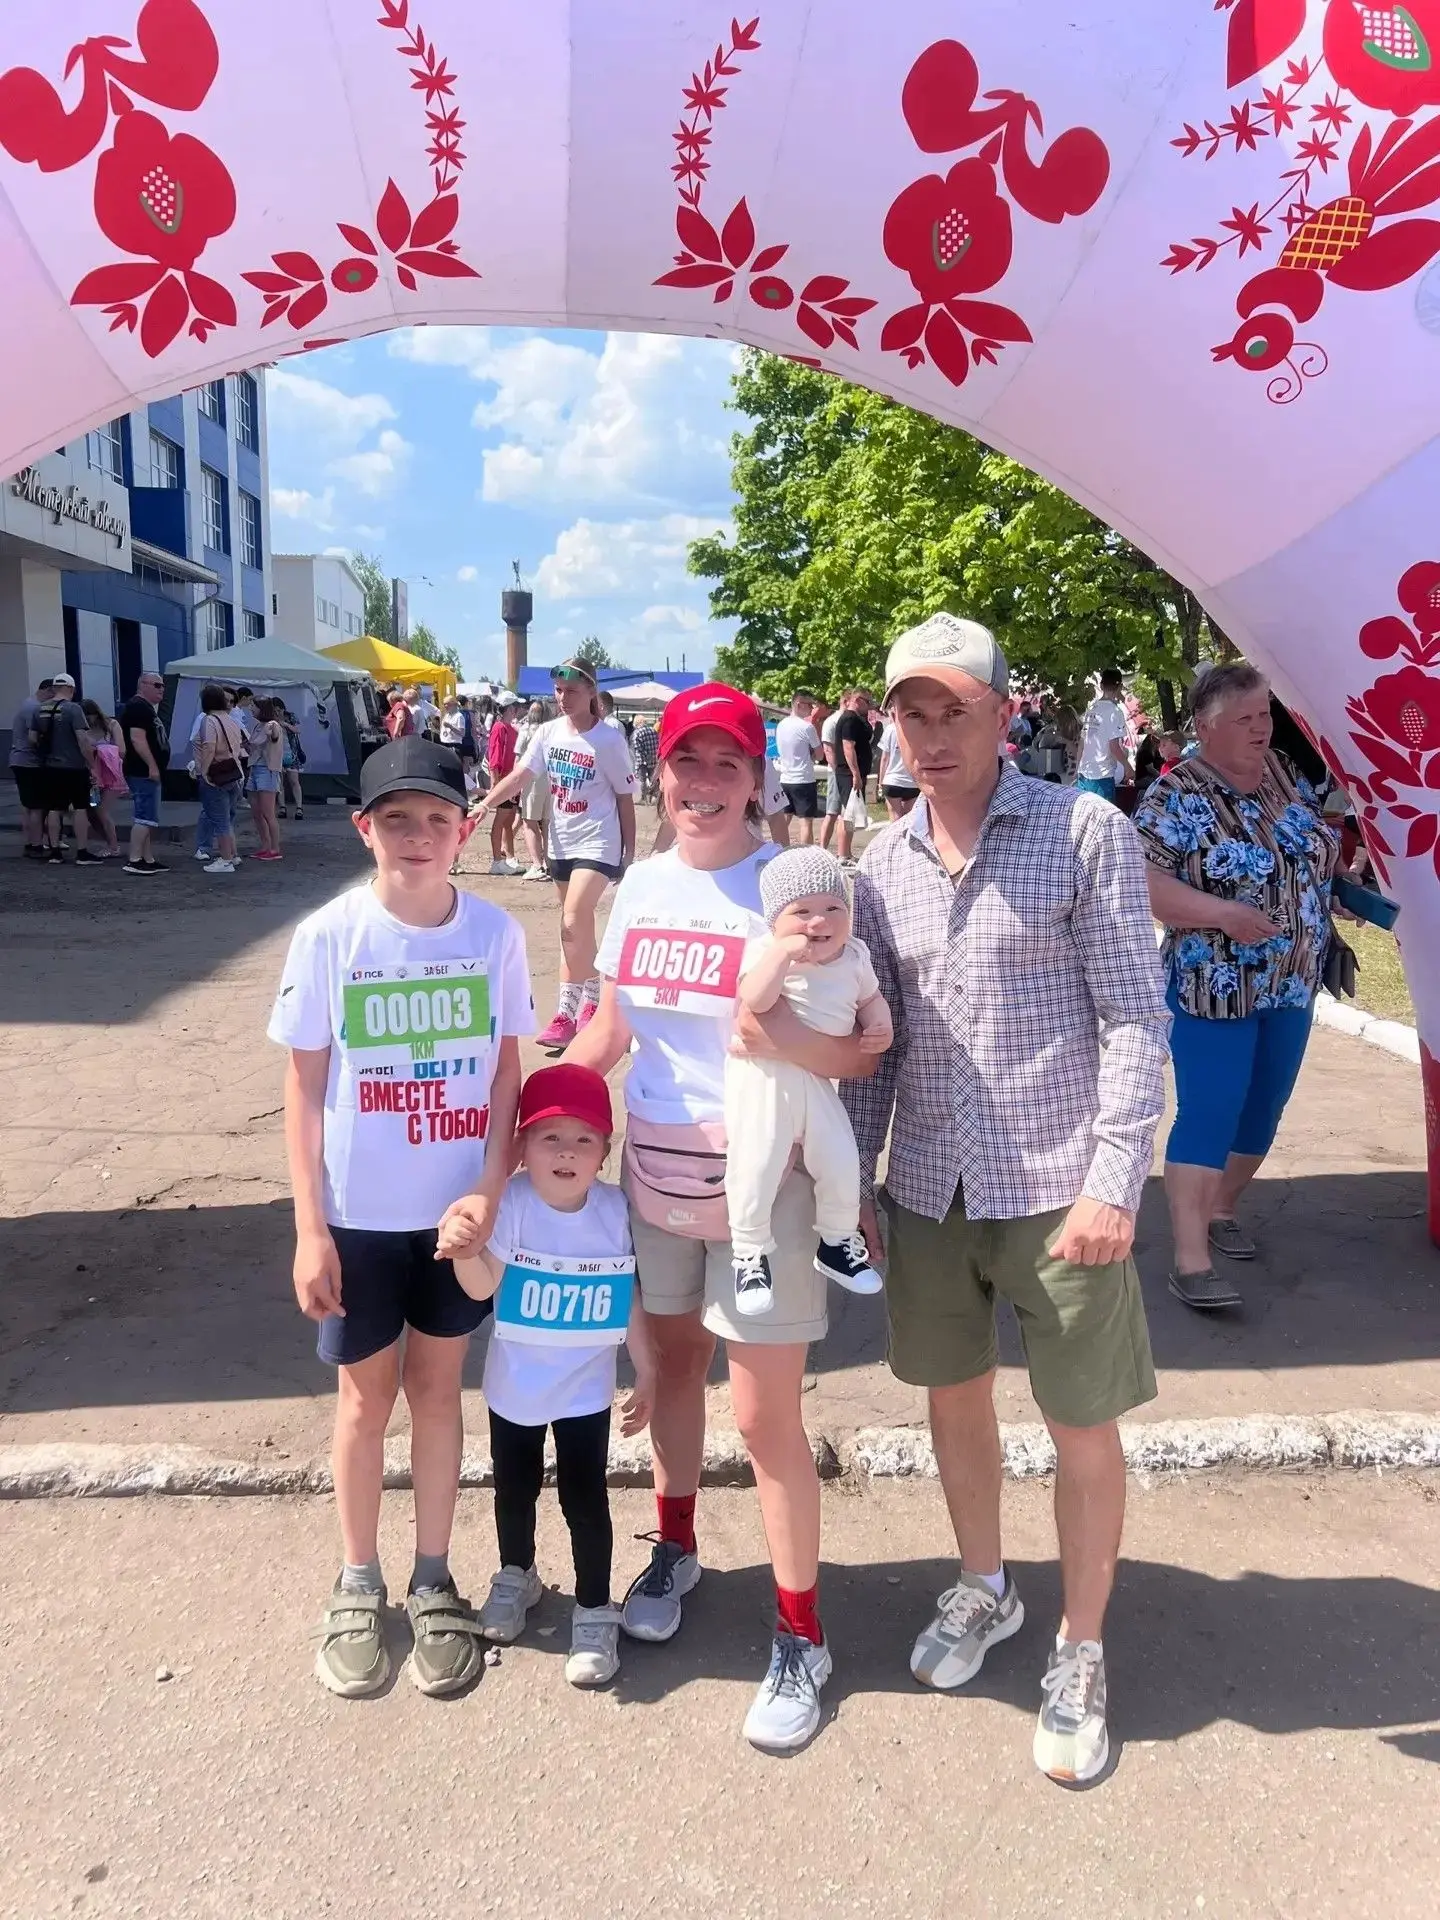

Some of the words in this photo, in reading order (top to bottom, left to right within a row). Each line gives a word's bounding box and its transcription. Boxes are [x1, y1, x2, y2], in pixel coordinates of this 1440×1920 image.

[556, 761, 596, 781] ПЛАНЕТЫ
[560, 775, 585, 790] БЕГУТ
[565, 800, 588, 814] ОБОЙ
[364, 970, 384, 978] ПСБ
[631, 938, 725, 986] 00502
[365, 987, 472, 1038] 00003
[359, 1079, 446, 1113] ВМЕСТЕ
[408, 1113, 423, 1145] С
[426, 1103, 490, 1143] ТОБОЙ
[525, 1257, 541, 1266] ПСБ
[520, 1279, 612, 1322] 00716
